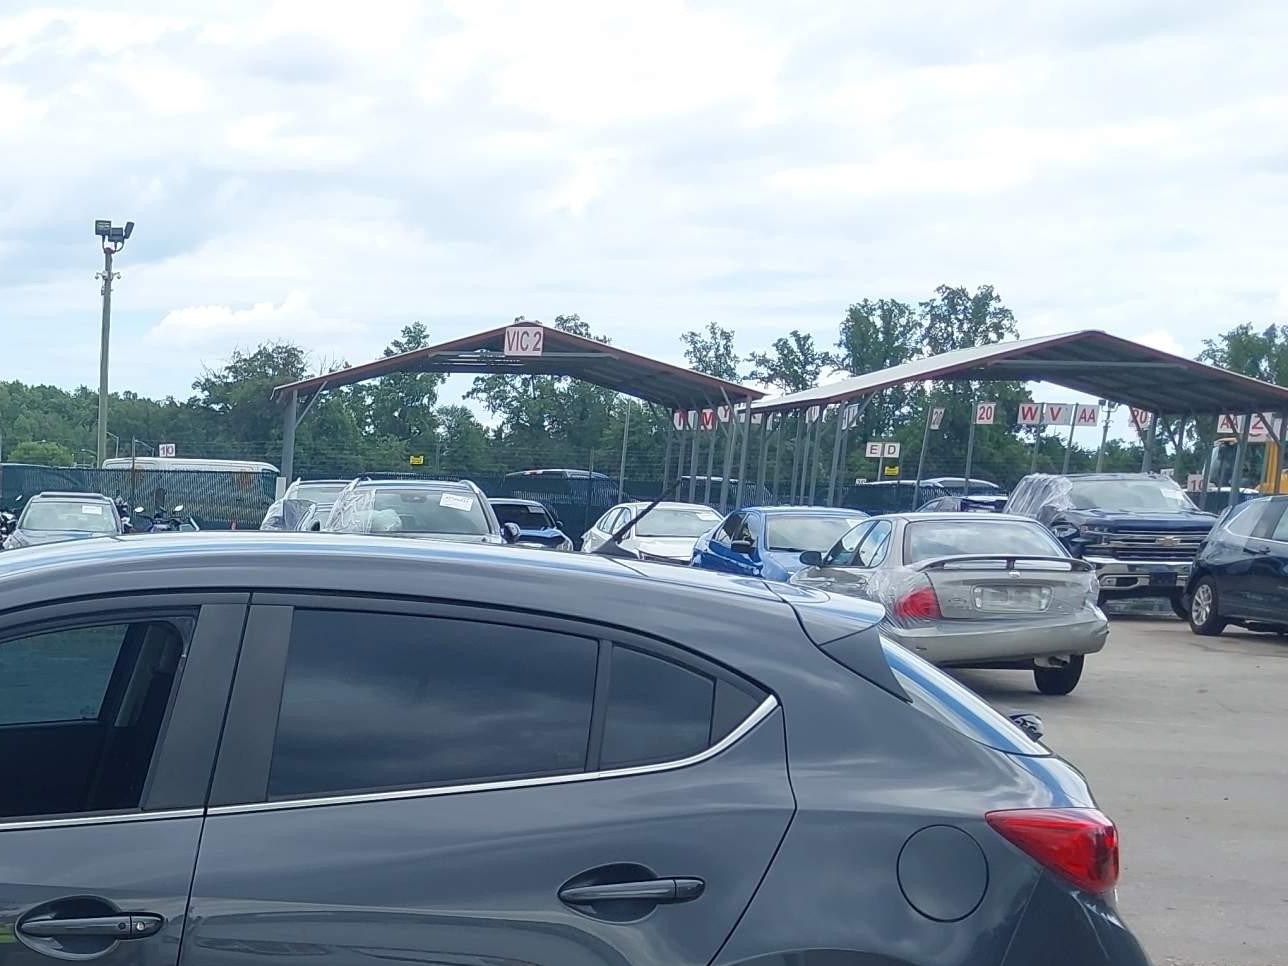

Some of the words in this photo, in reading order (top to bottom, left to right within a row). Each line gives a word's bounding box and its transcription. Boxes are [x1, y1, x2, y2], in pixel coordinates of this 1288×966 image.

[507, 330, 529, 351] VIC
[532, 331, 542, 351] 2
[978, 406, 993, 421] 20
[1022, 406, 1039, 421] W
[1050, 407, 1062, 421] V
[1078, 409, 1096, 423] AA
[161, 445, 174, 456] 10
[870, 445, 879, 455] E
[888, 445, 897, 455] D
